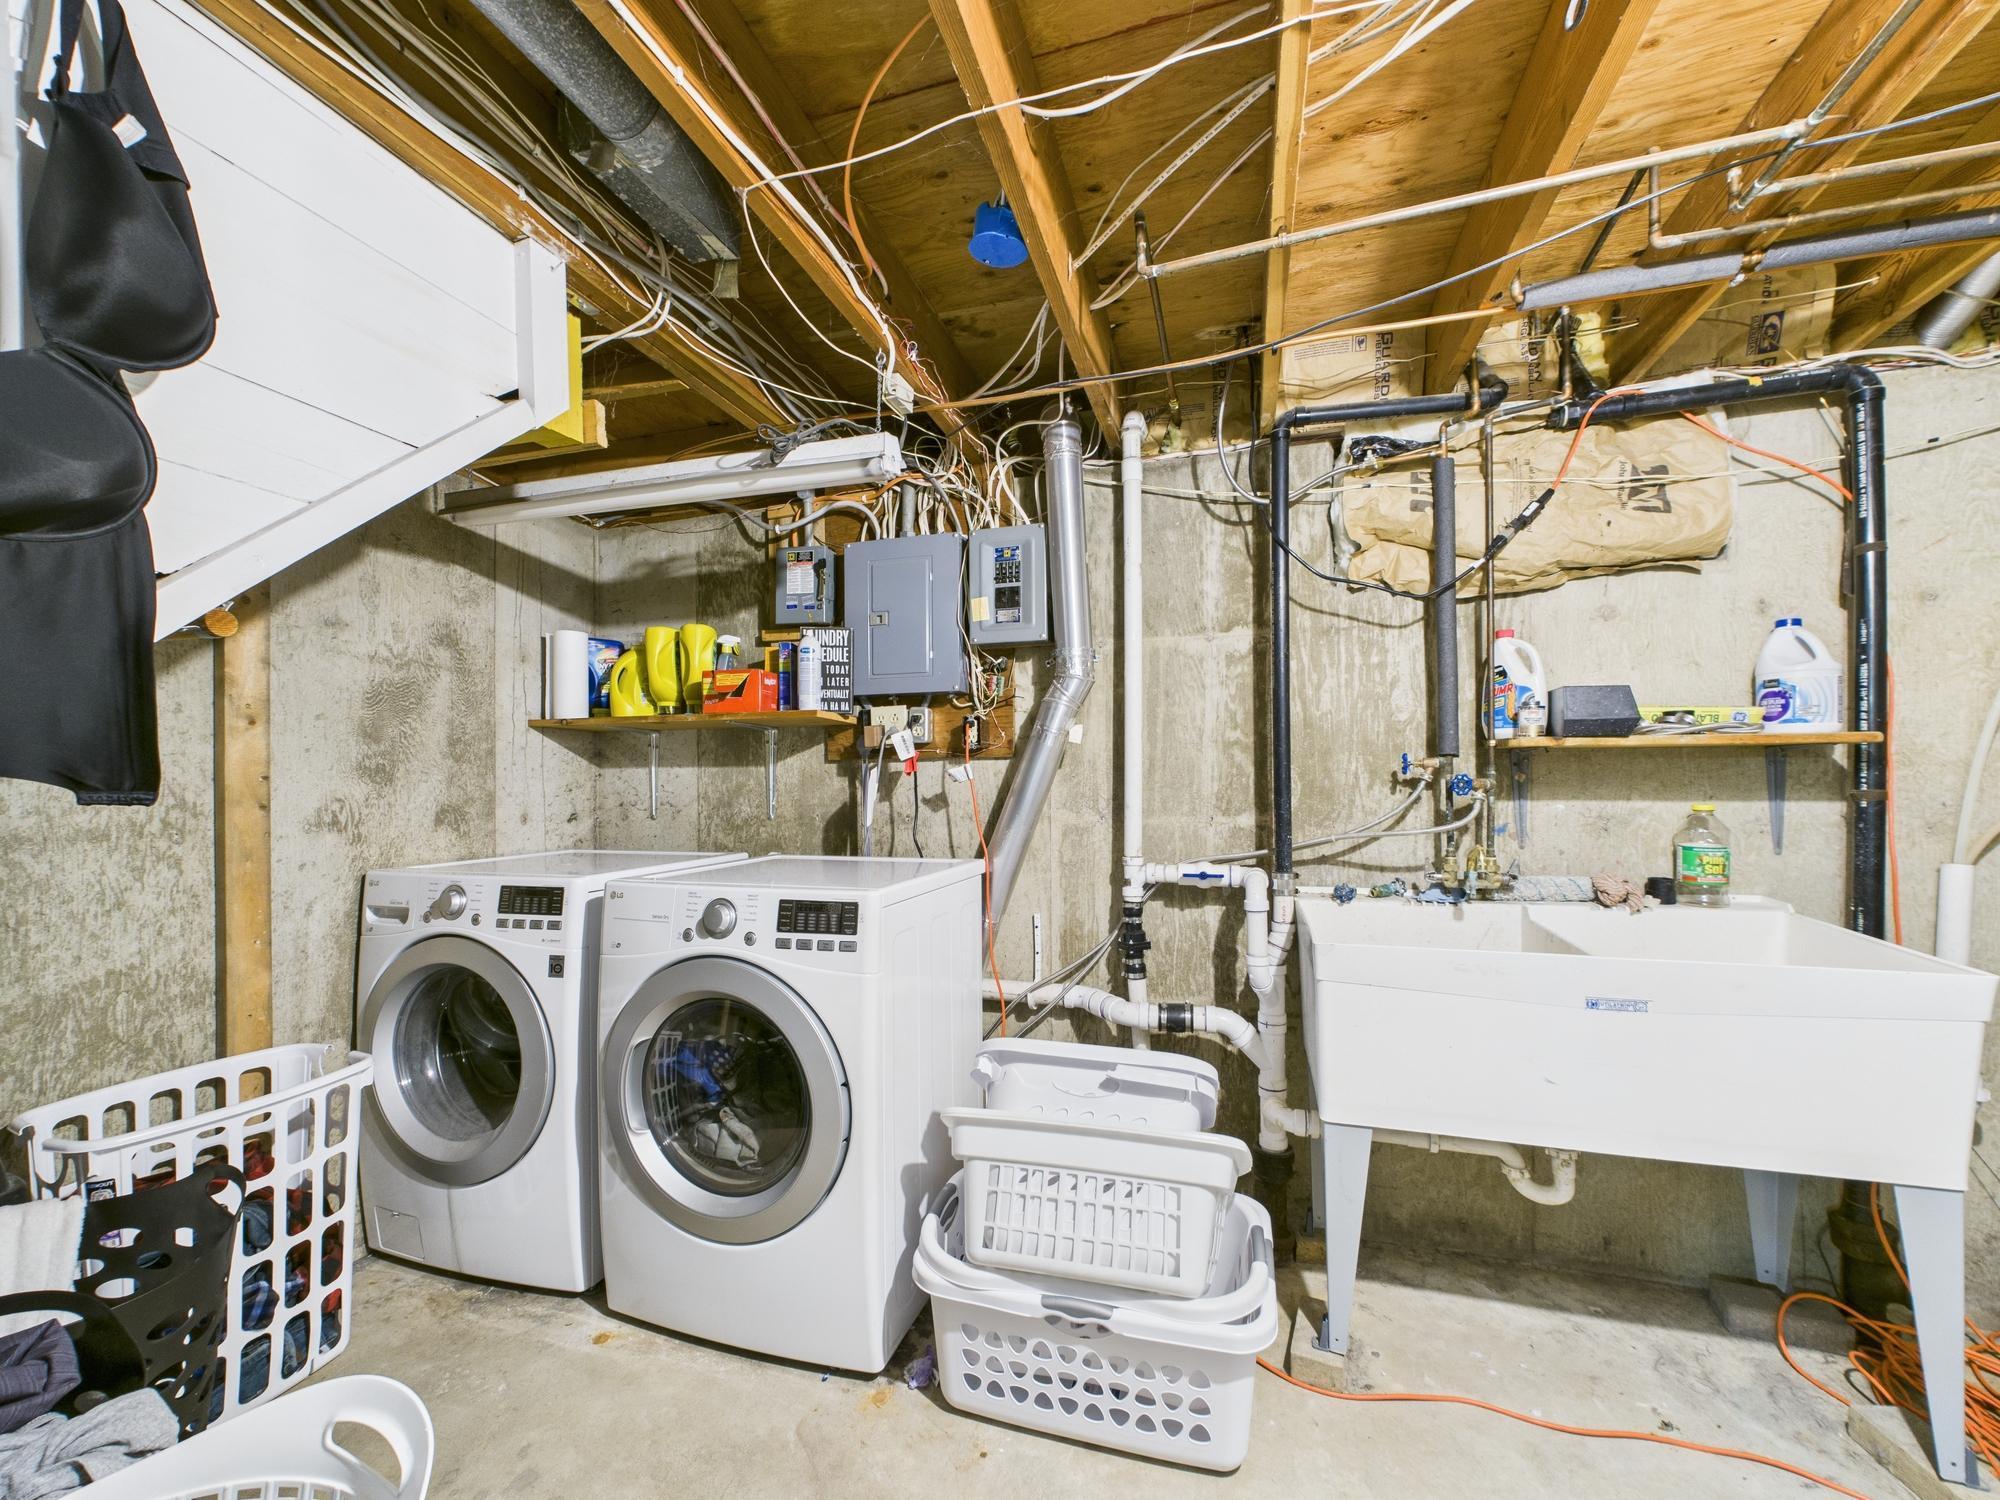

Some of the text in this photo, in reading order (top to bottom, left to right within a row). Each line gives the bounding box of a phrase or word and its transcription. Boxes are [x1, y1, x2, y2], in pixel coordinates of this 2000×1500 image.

[1380, 332, 1393, 400] GUARDI
[821, 647, 849, 662] EDULE
[826, 665, 849, 675] TODAY
[827, 677, 849, 687] LATER
[820, 690, 849, 699] VENTUALLY
[1494, 683, 1514, 697] UMR
[1704, 865, 1724, 875] Sol
